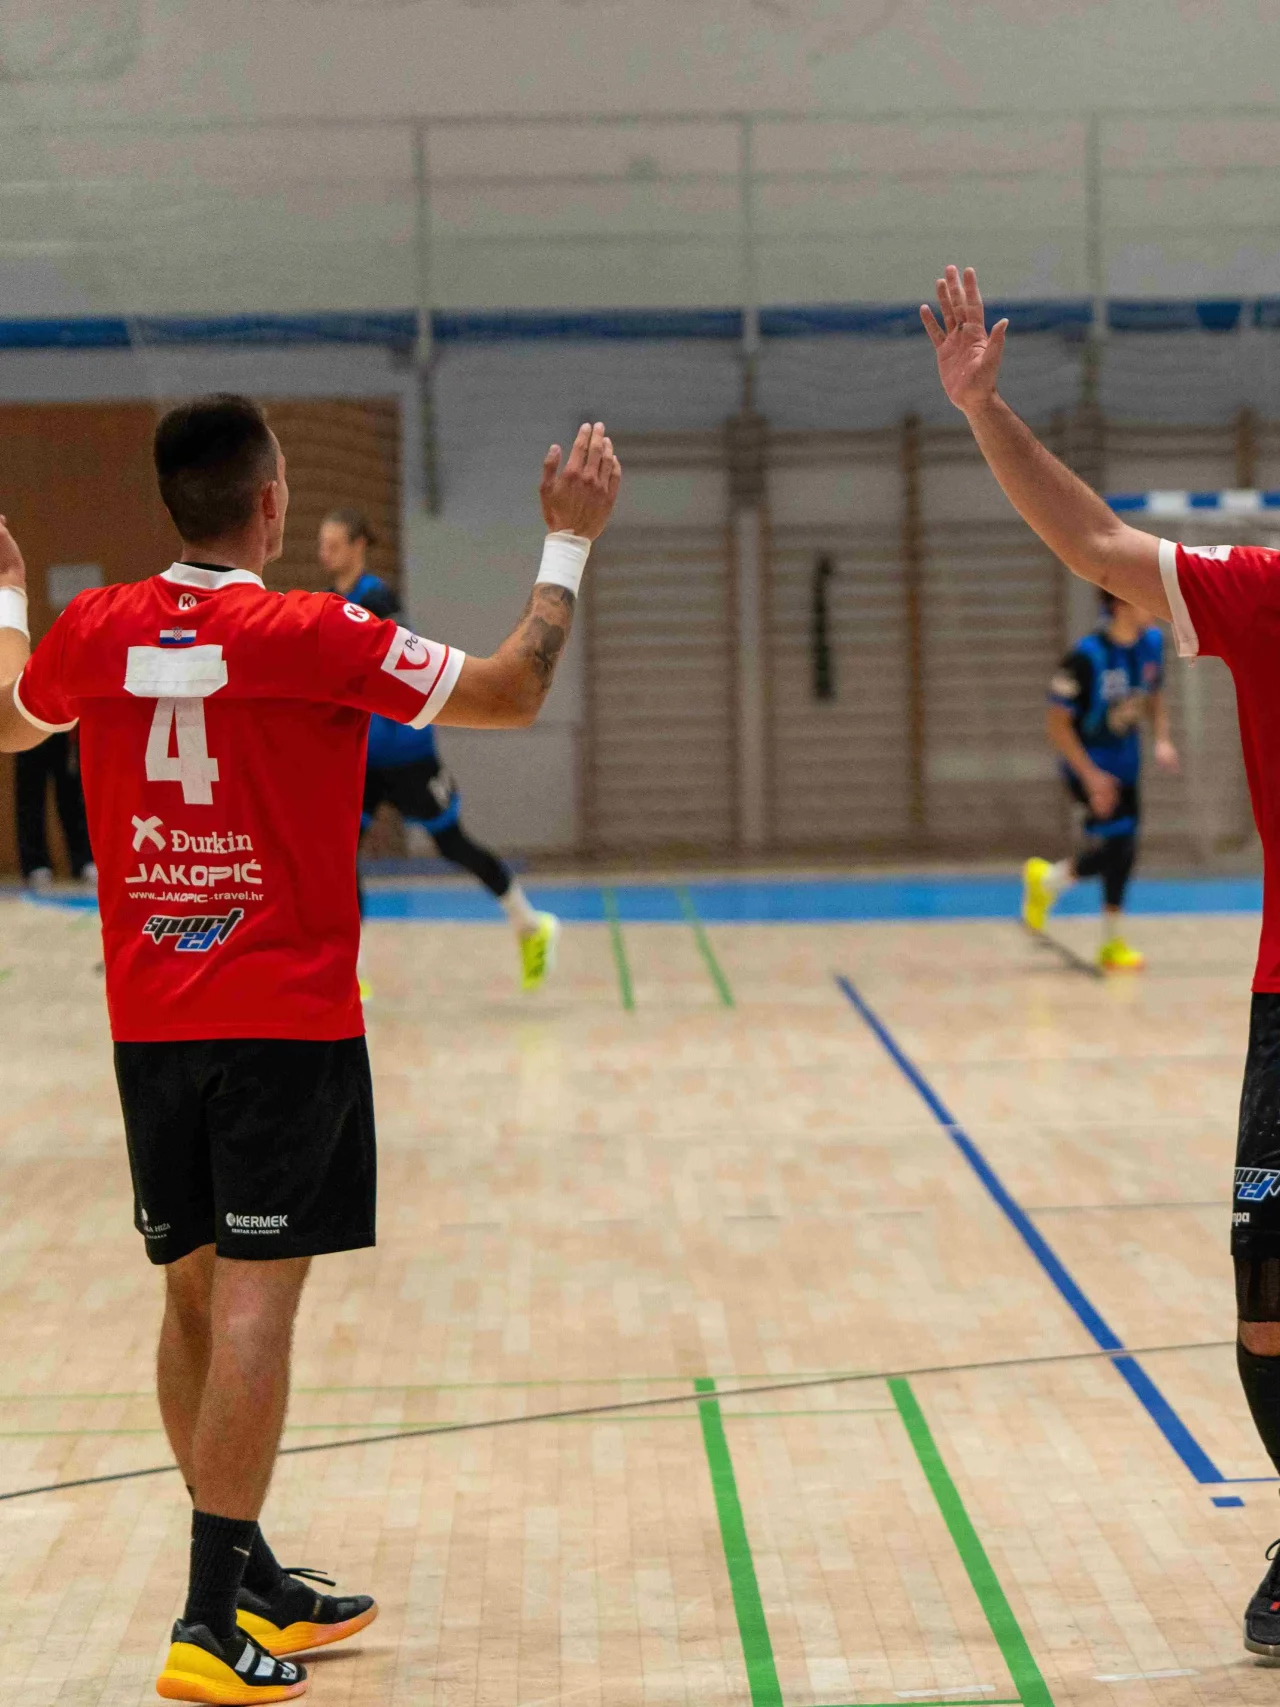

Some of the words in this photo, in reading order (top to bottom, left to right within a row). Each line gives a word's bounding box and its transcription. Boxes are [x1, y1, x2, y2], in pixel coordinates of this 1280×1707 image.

[144, 697, 220, 805] 4
[170, 829, 254, 854] Đurkin
[124, 858, 263, 888] JAKOPIĆ
[235, 1214, 289, 1228] KERMEK
